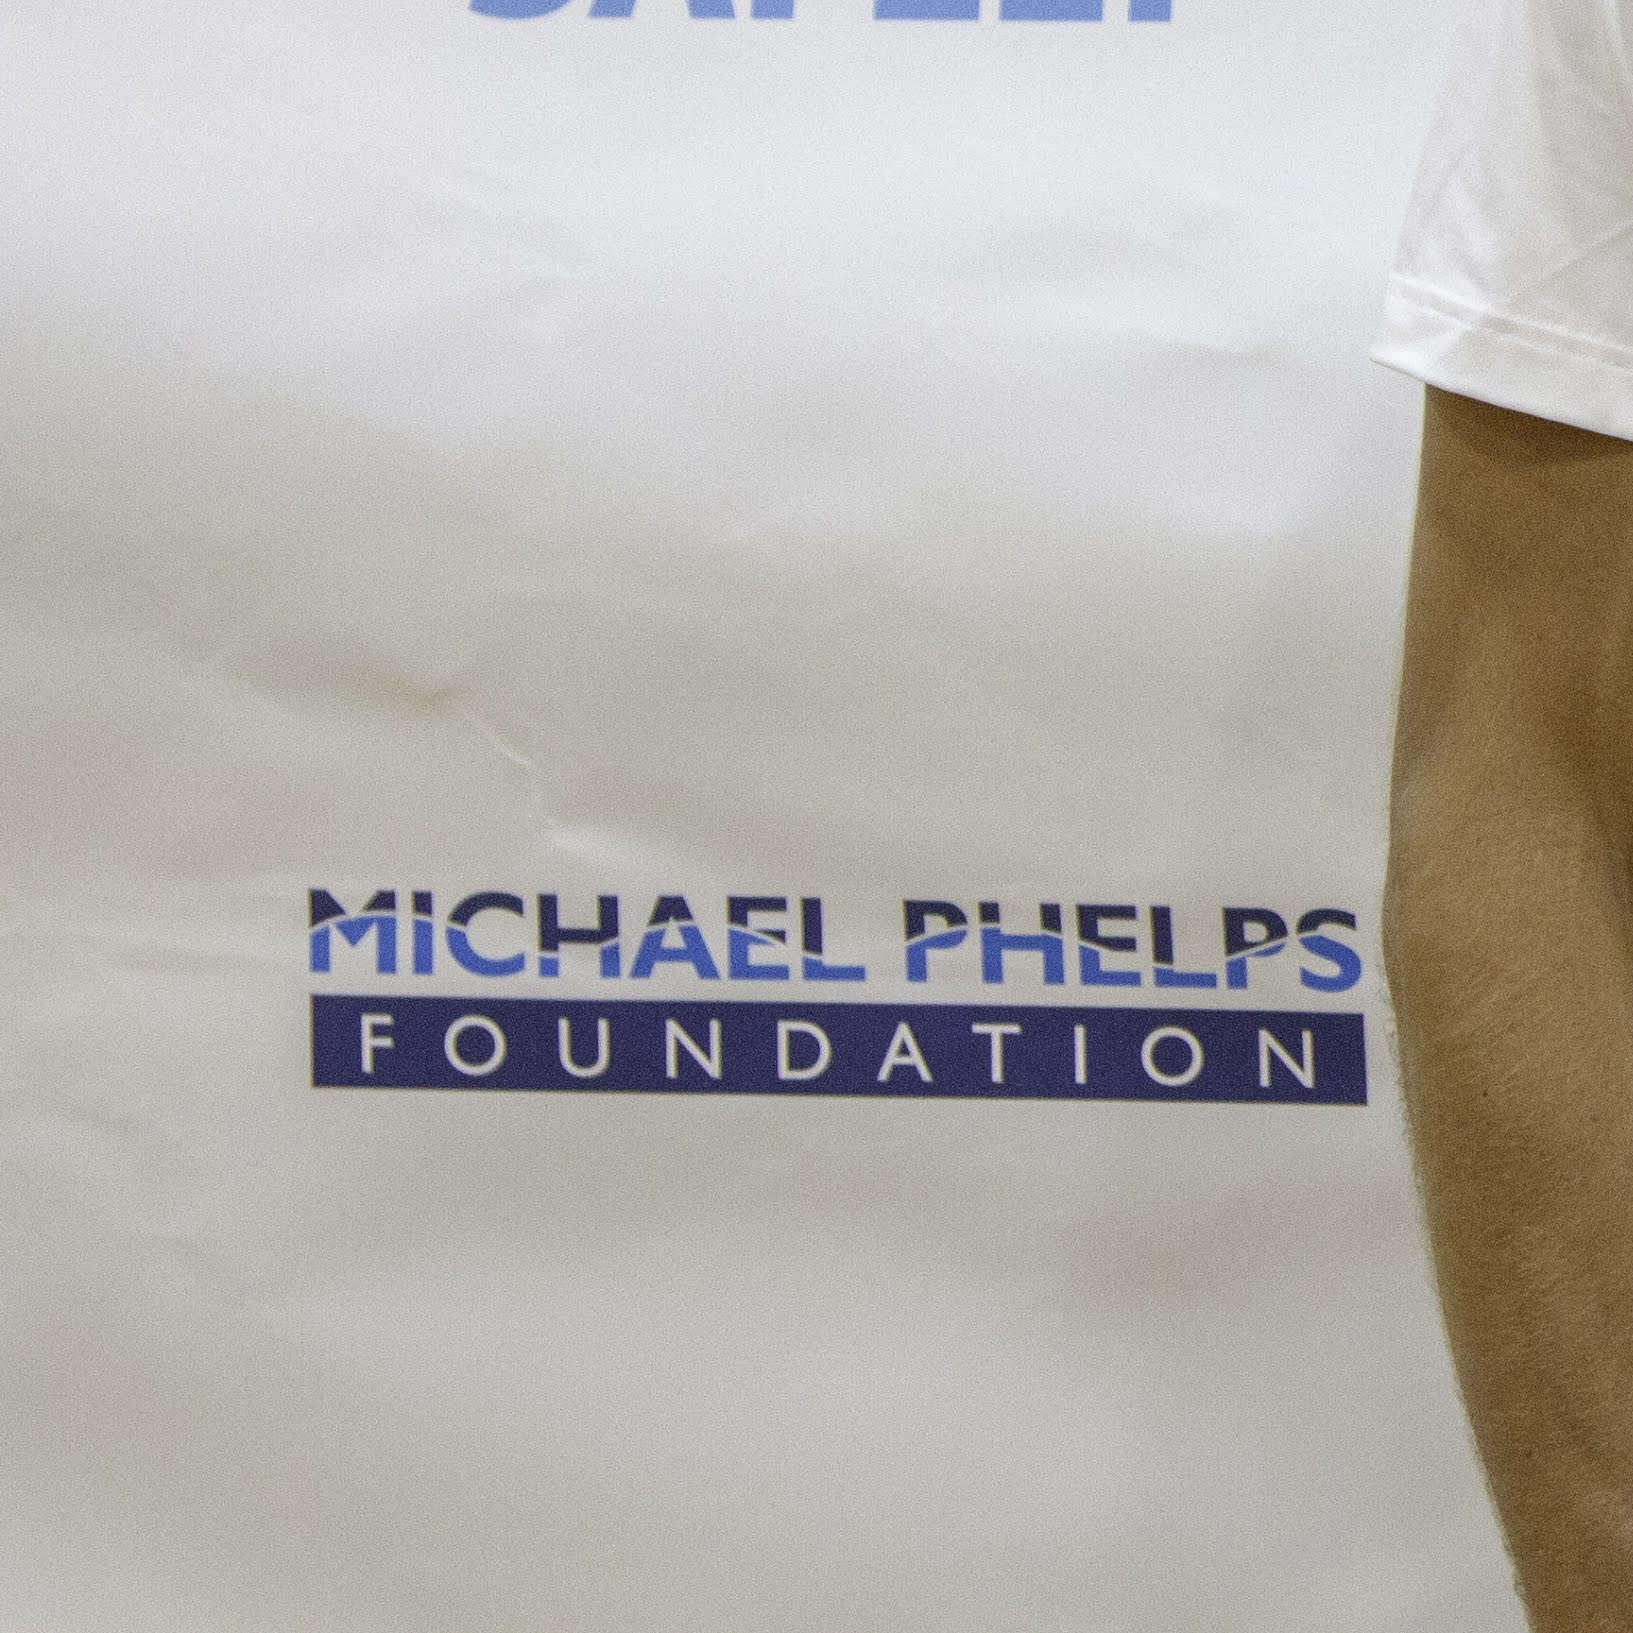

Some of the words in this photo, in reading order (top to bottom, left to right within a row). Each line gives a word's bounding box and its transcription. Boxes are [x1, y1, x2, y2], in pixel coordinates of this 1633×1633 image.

[309, 889, 867, 983] MICHAEL
[902, 898, 1364, 993] PHELPS
[359, 1013, 1317, 1089] FOUNDATION
